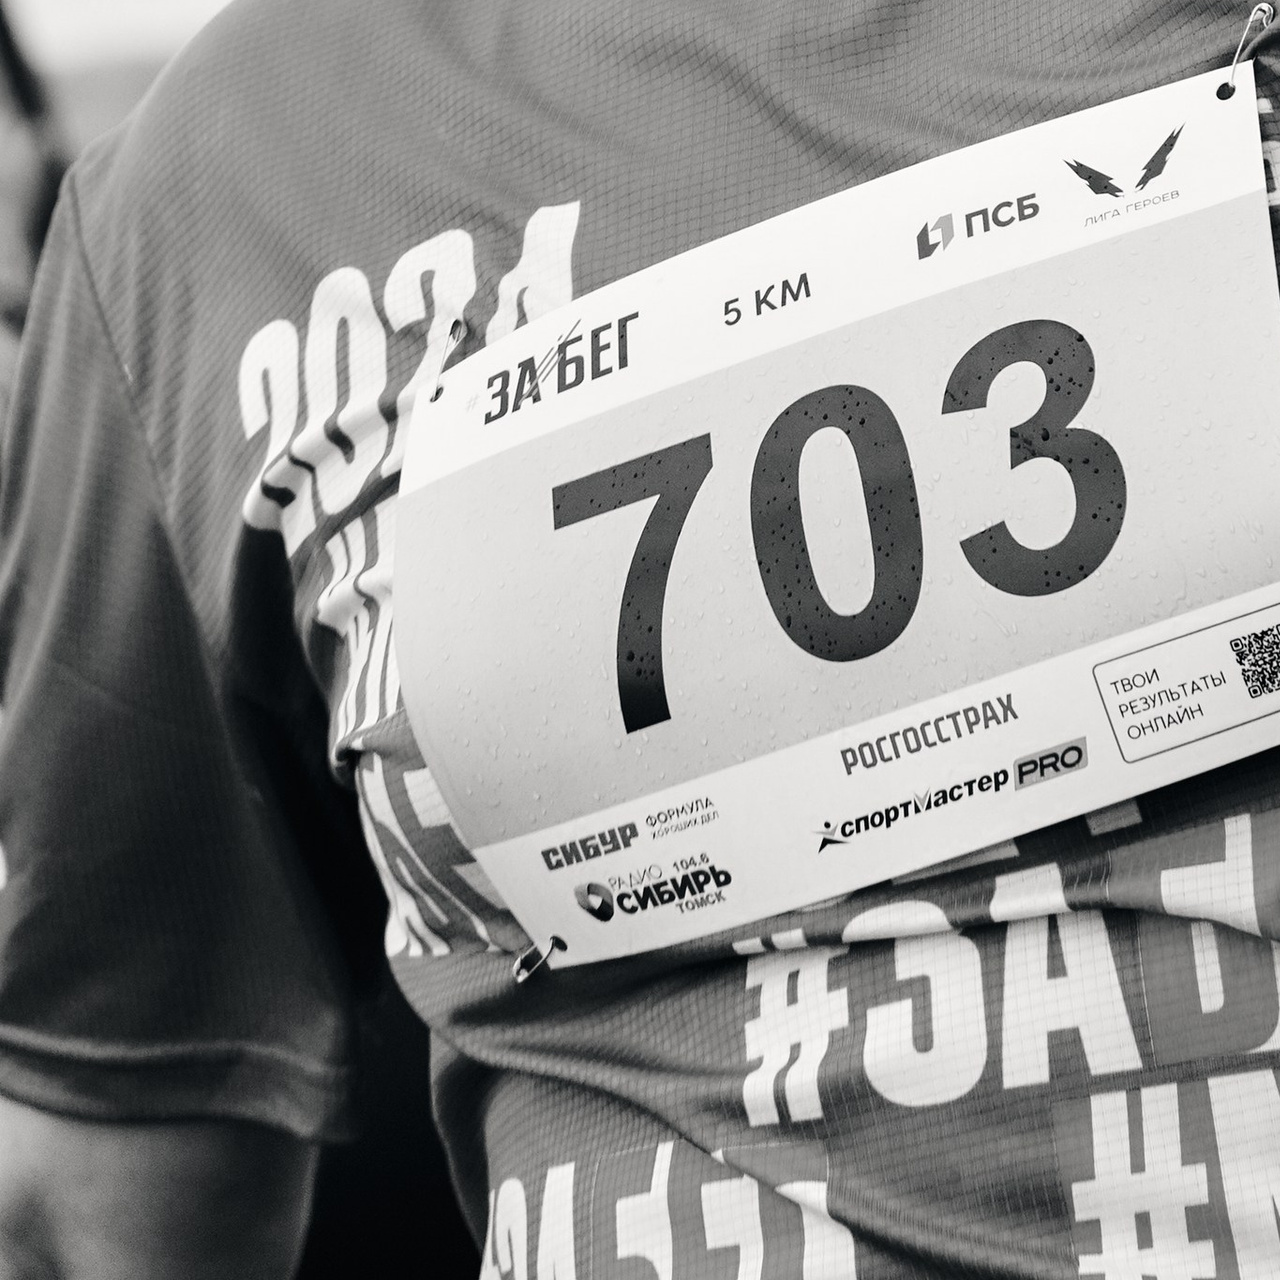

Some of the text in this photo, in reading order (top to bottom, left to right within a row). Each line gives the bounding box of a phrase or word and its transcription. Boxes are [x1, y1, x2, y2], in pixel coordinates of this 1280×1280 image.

[964, 193, 1040, 238] ПСБ
[1083, 190, 1181, 228] ЛИГА ГЕРОЕВ
[723, 273, 812, 326] 5 КМ
[551, 320, 1127, 734] 703
[1110, 668, 1160, 696] ТВОИ
[1118, 670, 1226, 718] РЕЗУЛЬТАТЫ
[840, 693, 1018, 776] РОСГОССТРАХ
[1127, 703, 1204, 740] ОНЛАЙН
[1017, 744, 1084, 786] PRO
[541, 796, 715, 871] СИБУР ФОРМУЛА
[608, 864, 663, 890] РАДИО
[616, 864, 732, 915] СИБИРЬ
[675, 890, 726, 915] ТОМСК
